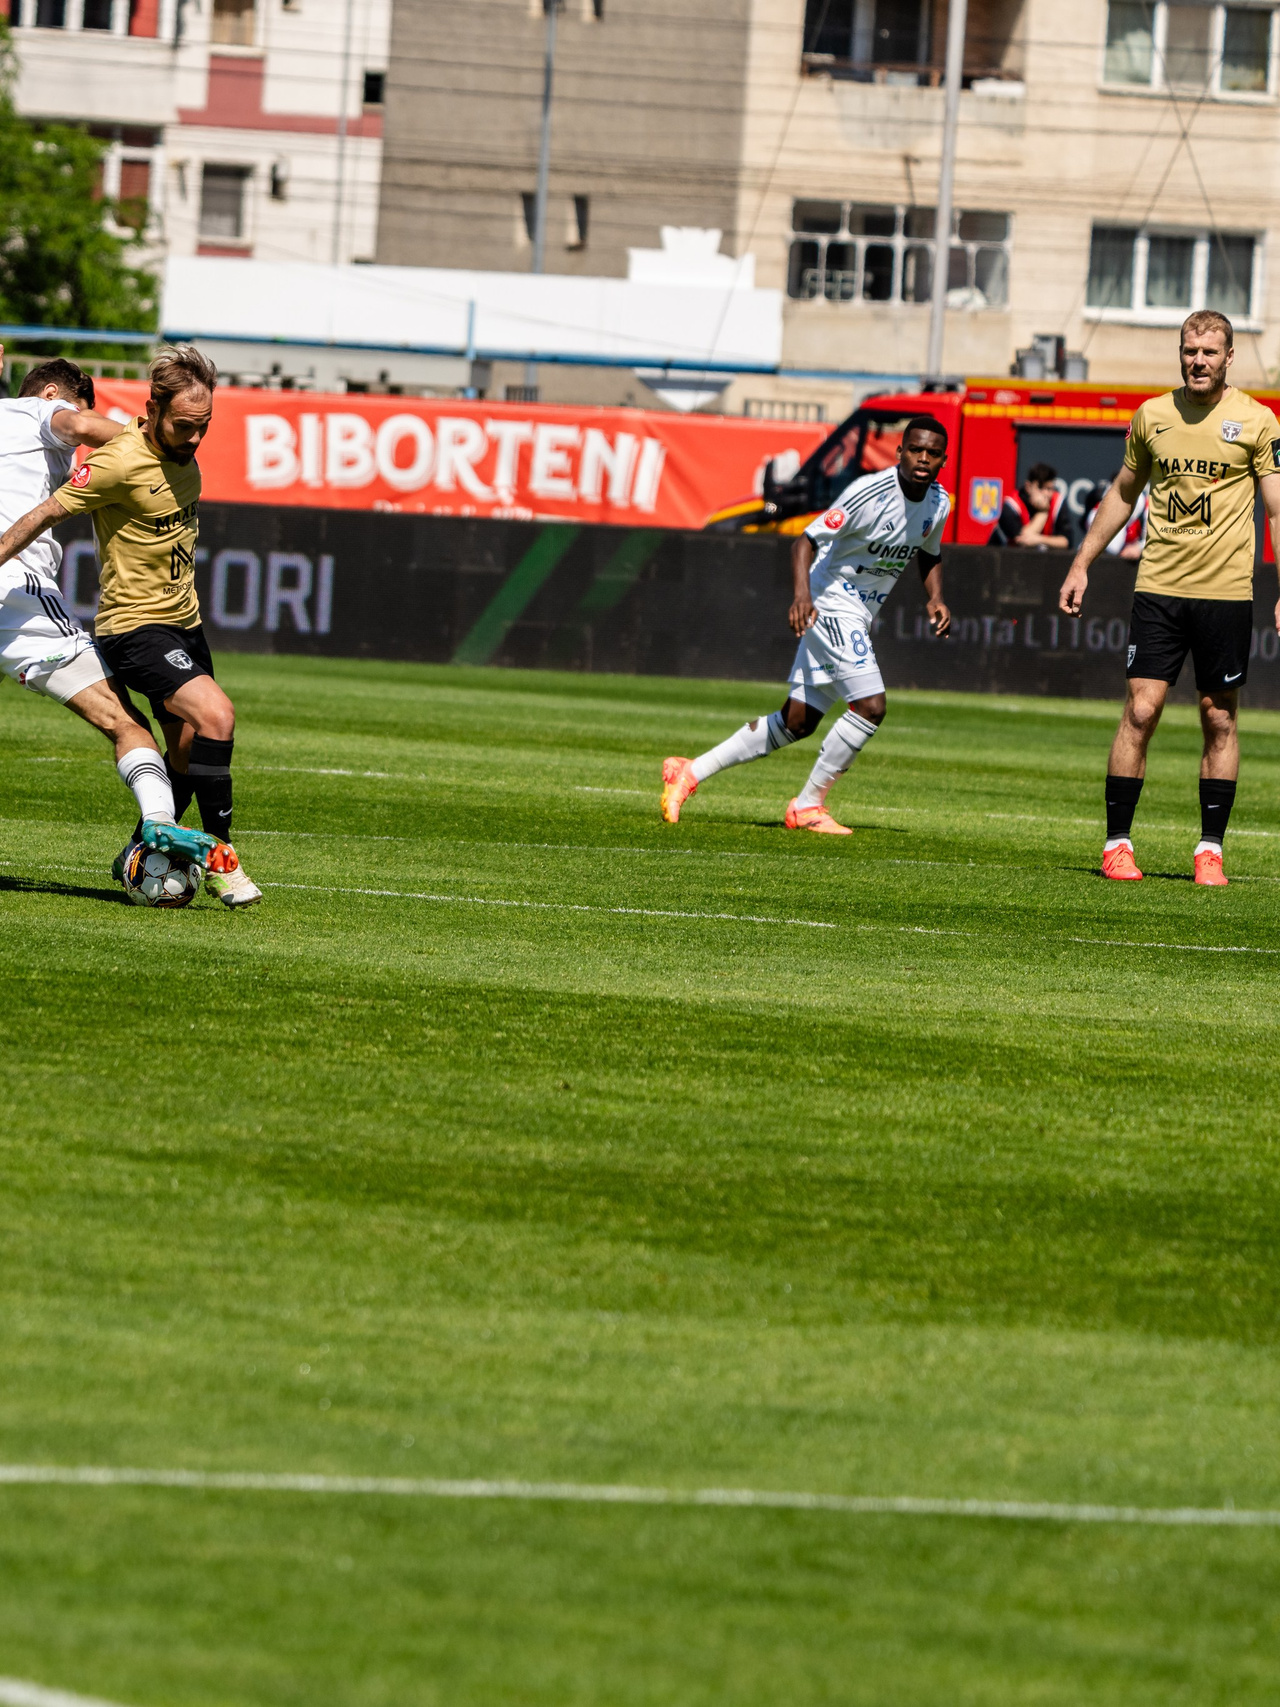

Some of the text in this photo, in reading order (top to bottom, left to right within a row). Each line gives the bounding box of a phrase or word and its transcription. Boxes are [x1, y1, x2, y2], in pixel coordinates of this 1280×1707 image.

[245, 413, 667, 513] BIBORTENI
[1159, 458, 1230, 479] MAXBET
[155, 500, 198, 533] MAXB
[1160, 526, 1203, 536] METROPOLA
[867, 541, 919, 560] UNIBE
[163, 582, 192, 595] METROP
[850, 629, 875, 657] 8
